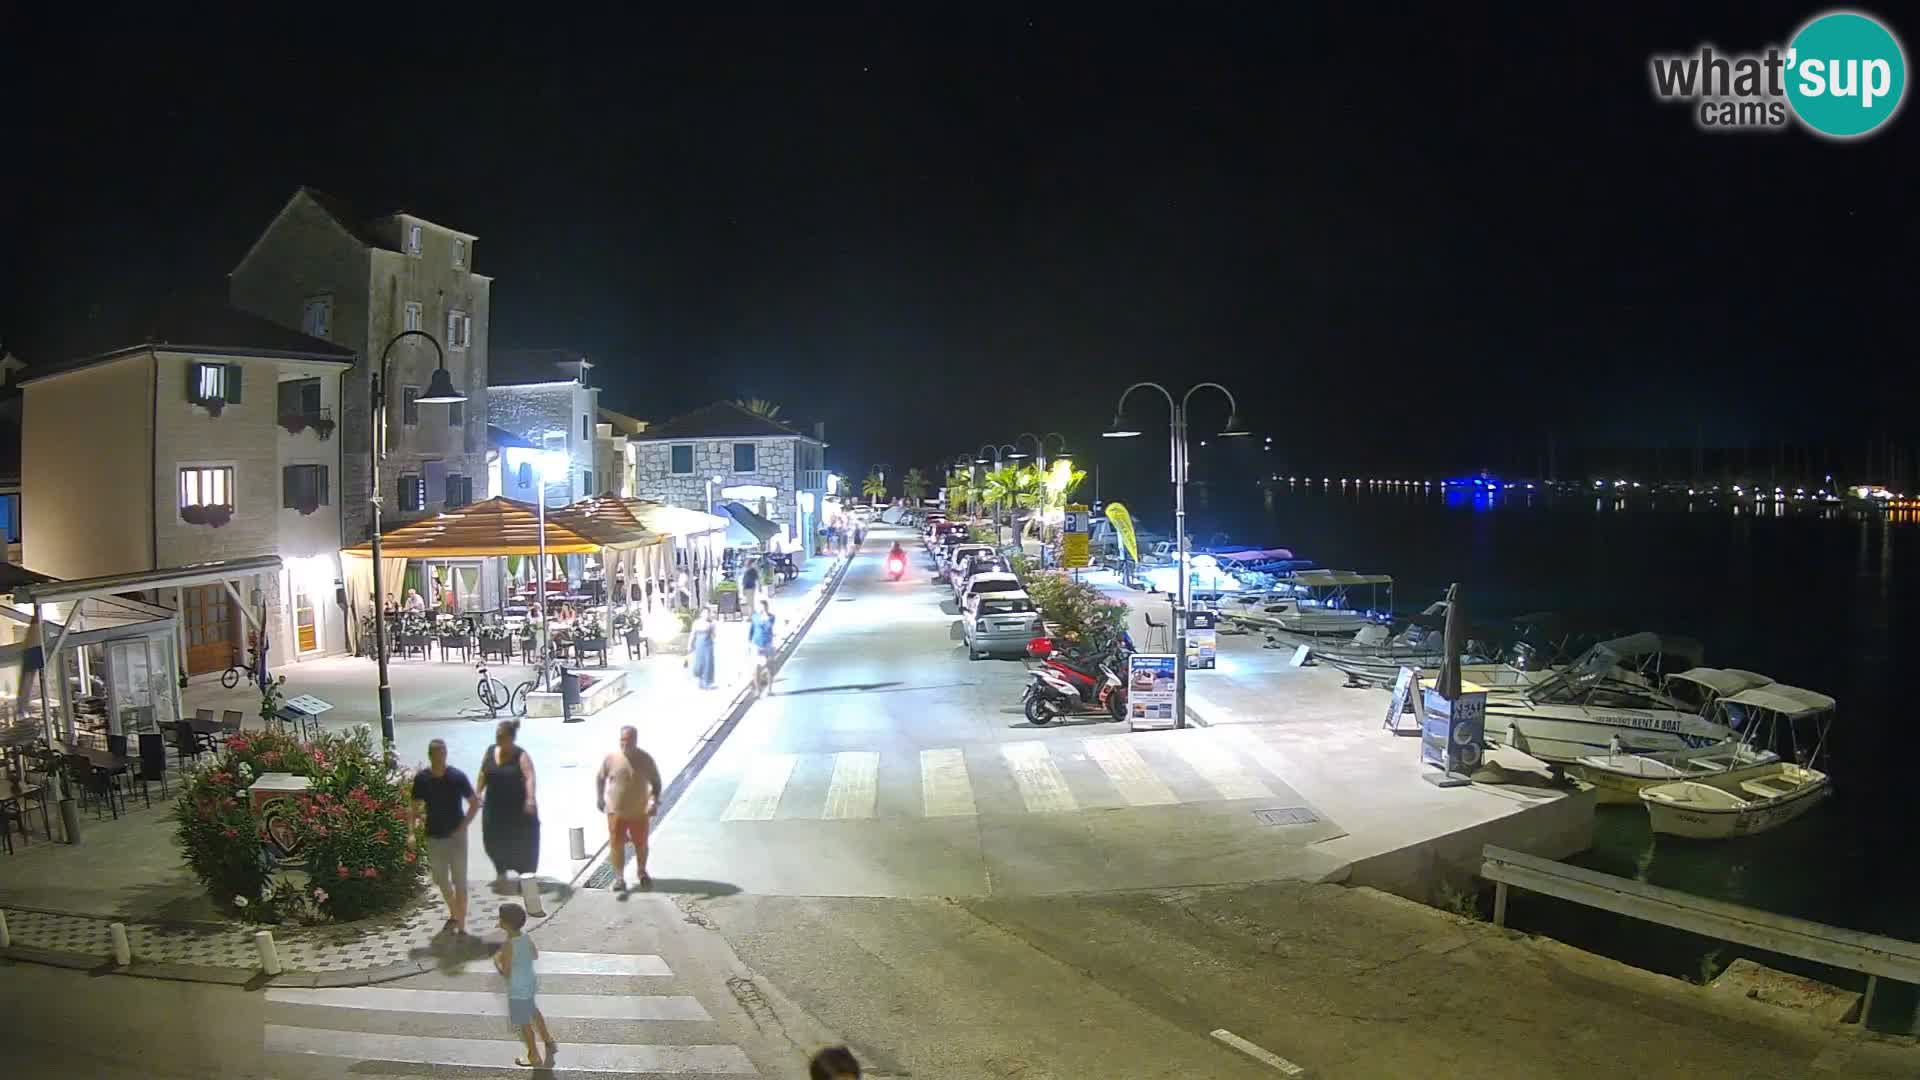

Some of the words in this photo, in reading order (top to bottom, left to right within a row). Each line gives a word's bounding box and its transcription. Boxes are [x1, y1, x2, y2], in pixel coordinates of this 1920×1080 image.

[1066, 514, 1076, 531] P
[1632, 718, 1653, 729] RENT
[1661, 720, 1681, 732] BOAT
